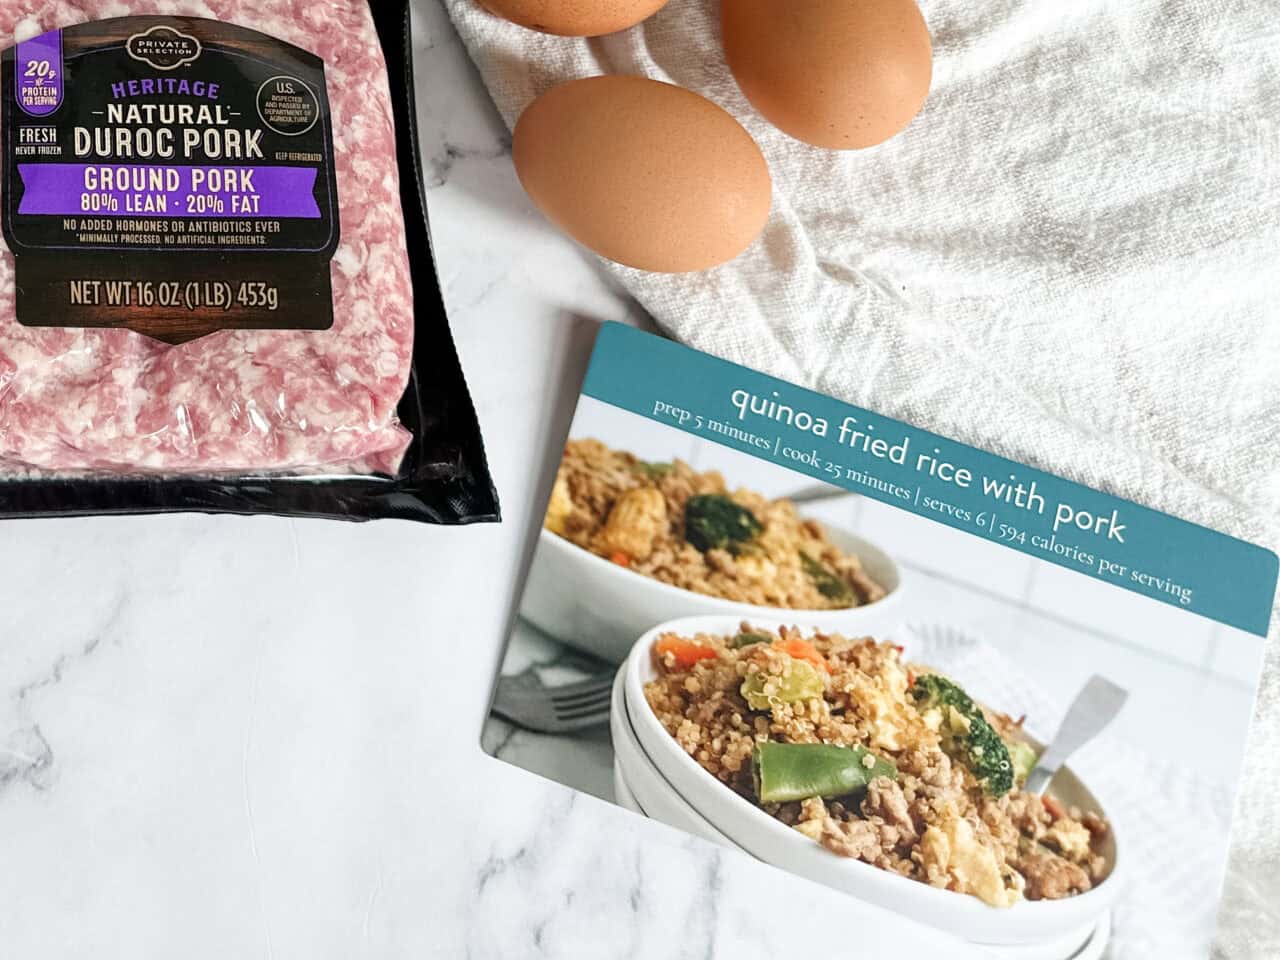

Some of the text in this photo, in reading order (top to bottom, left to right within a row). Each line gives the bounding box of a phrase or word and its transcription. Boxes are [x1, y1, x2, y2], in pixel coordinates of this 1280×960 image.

[138, 40, 189, 49] PRIVATE
[23, 60, 56, 80] 20g
[22, 86, 57, 97] PROTEIN
[111, 77, 220, 100] HERITAGE
[276, 81, 296, 94] U.S.
[23, 96, 34, 106] PER
[19, 128, 57, 143] FRESH
[74, 127, 265, 160] DUROC PORK
[15, 145, 62, 155] NEVER FROZEN
[84, 166, 256, 193] GROUND PORK
[80, 193, 261, 214] 80% LEAN 20% FAT
[63, 218, 281, 233] NO ADDED HORMONES OR ANTIBIOTICS EVER
[164, 235, 175, 244] NO
[176, 235, 216, 245] ARTIFICIAL
[70, 280, 101, 306] NET
[106, 281, 132, 306] WT
[136, 282, 155, 306] 16
[158, 283, 182, 307] OZ
[237, 284, 279, 311] 453g
[730, 386, 1128, 544] quinoa fried rice with pork
[652, 399, 1193, 605] prep 5 minutes cook 25 minutes serves 6 594 calories per serving
